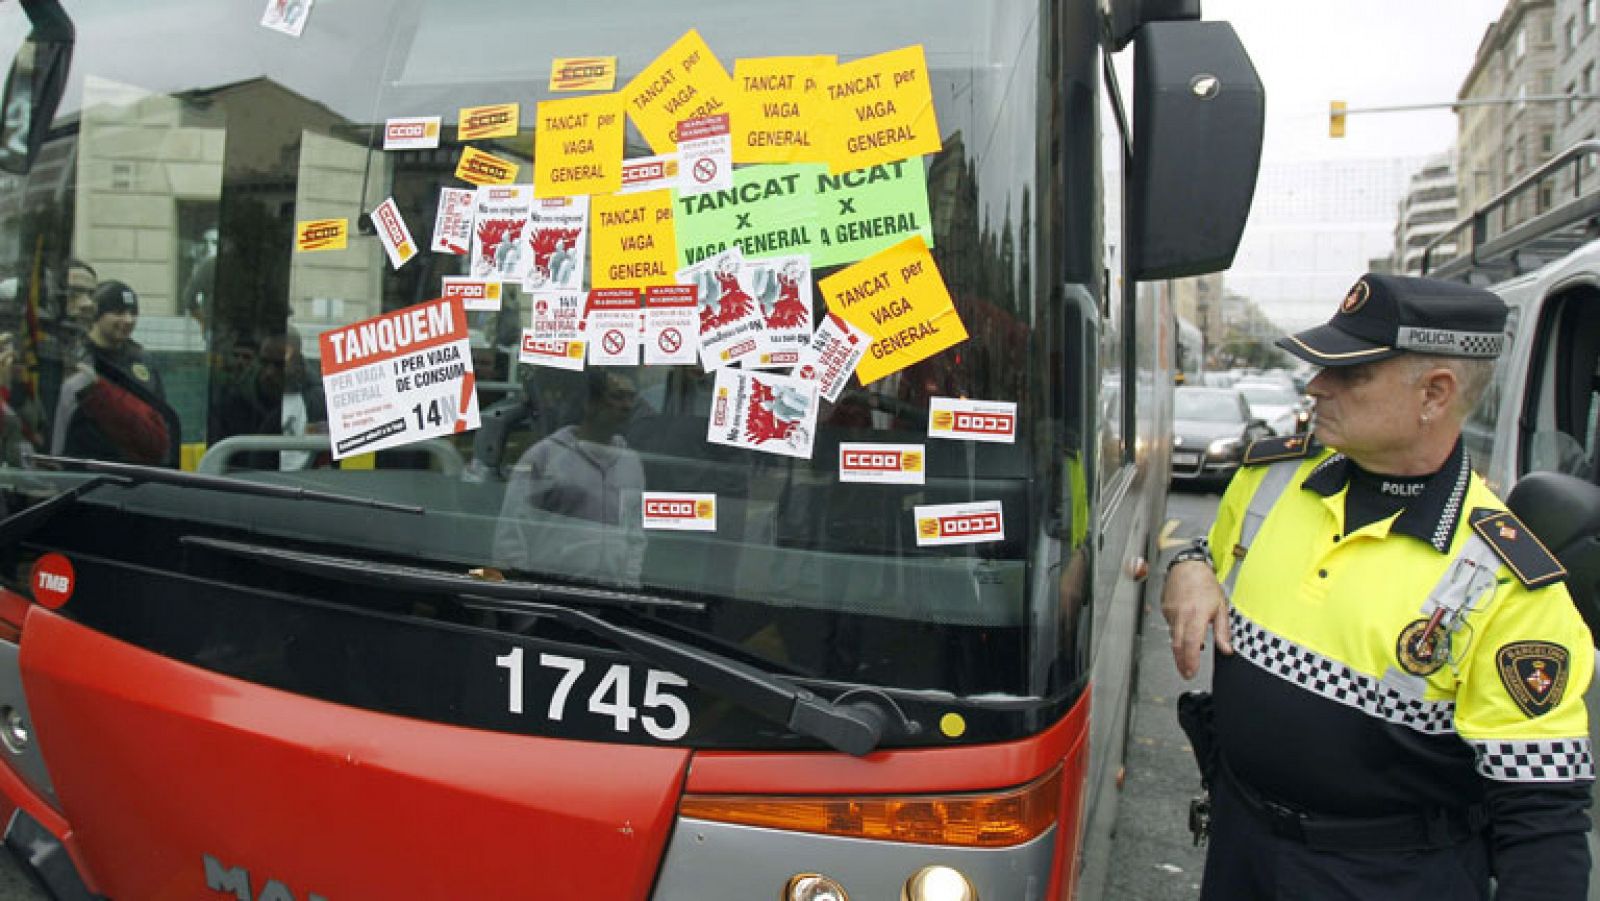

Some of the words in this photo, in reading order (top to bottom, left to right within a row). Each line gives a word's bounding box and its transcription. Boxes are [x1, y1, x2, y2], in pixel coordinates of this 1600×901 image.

[633, 69, 677, 110] TANCAT
[682, 50, 701, 73] per
[744, 75, 795, 91] TANCAT
[827, 73, 881, 101] TANCAT
[893, 69, 916, 89] per
[663, 85, 698, 114] VAGA
[763, 103, 800, 118] VAGA
[855, 100, 896, 121] VAGA
[545, 114, 589, 132] TANCAT
[598, 114, 616, 129] per
[562, 138, 595, 156] VAGA
[748, 131, 811, 147] GENERAL
[847, 125, 916, 153] GENERAL
[551, 169, 606, 183] GENERAL
[816, 159, 908, 194] NCAT
[679, 174, 801, 215] TANCAT
[600, 208, 646, 226] TANCAT
[836, 212, 921, 243] GENERAL
[621, 235, 654, 251] VAGA
[609, 262, 667, 280] GENERAL
[836, 271, 891, 309] TANCAT
[901, 260, 923, 283] per
[871, 297, 913, 325] VAGA
[329, 302, 454, 364] TANQUEM
[871, 320, 940, 360] GENERAL
[1410, 329, 1455, 345] POLICIA
[402, 355, 426, 372] PER
[427, 345, 461, 366] VAGA
[331, 373, 354, 392] PER
[356, 364, 386, 385] VAGA
[395, 377, 412, 393] DE
[413, 362, 466, 389] CONSUM
[332, 384, 382, 408] GENERAL
[846, 452, 899, 469] CCOO
[646, 502, 695, 517] CCOO
[38, 572, 70, 593] TMB
[496, 646, 692, 740] 1745
